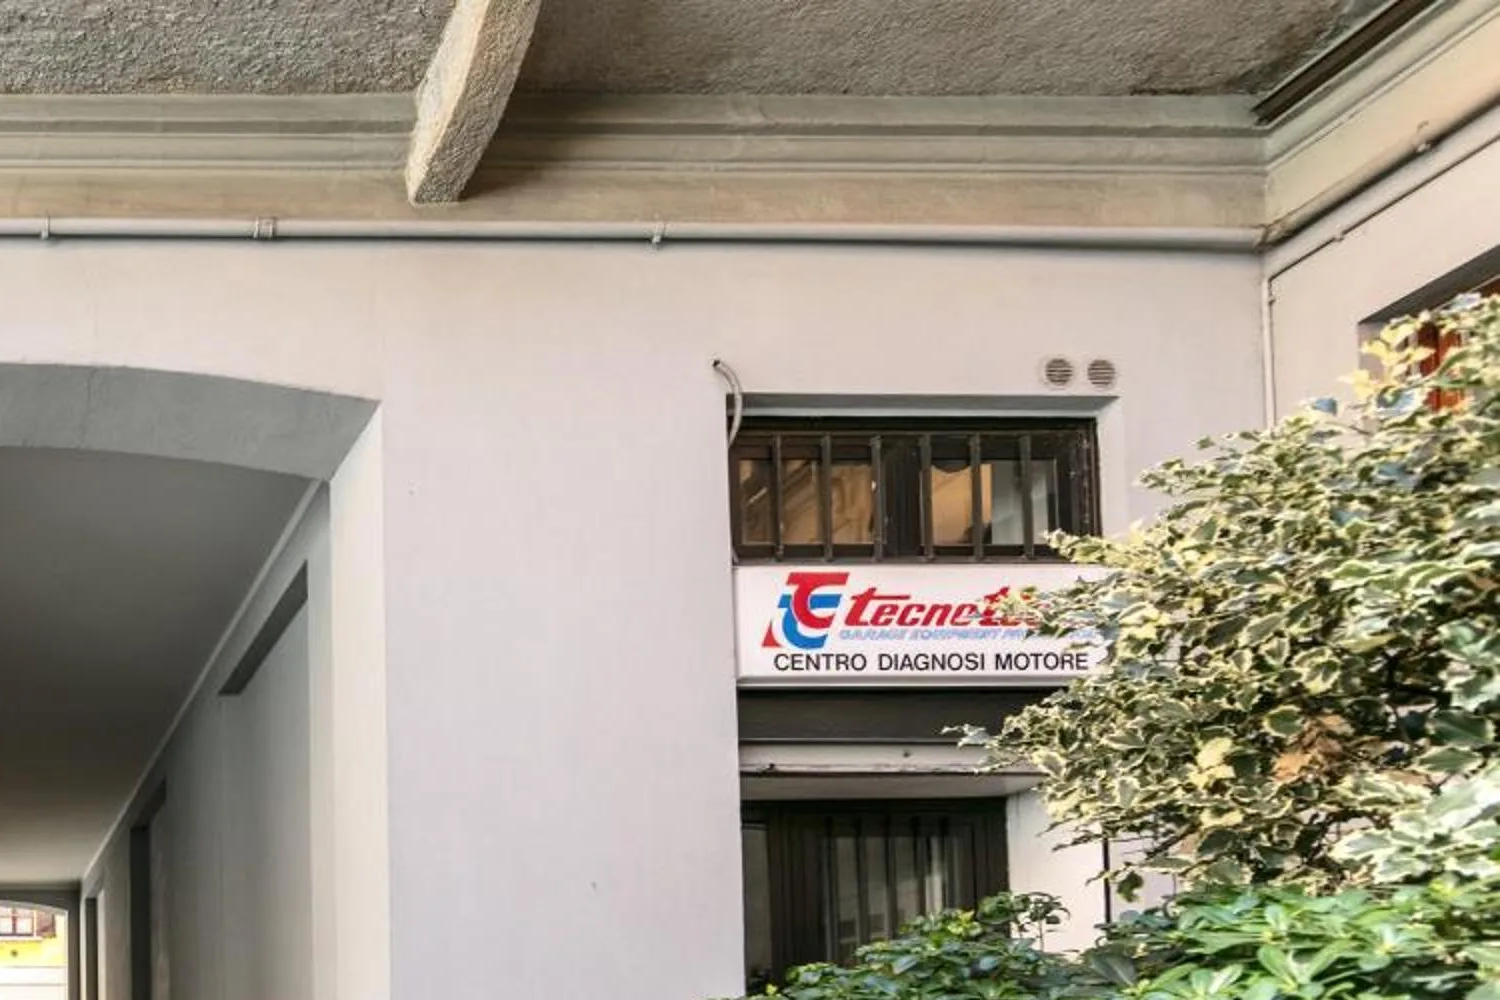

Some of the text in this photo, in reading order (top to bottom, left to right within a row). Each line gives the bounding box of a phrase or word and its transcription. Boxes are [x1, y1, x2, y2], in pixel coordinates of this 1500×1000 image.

[773, 653, 1089, 671] CENTRO DIAGNOSI MOTORE
